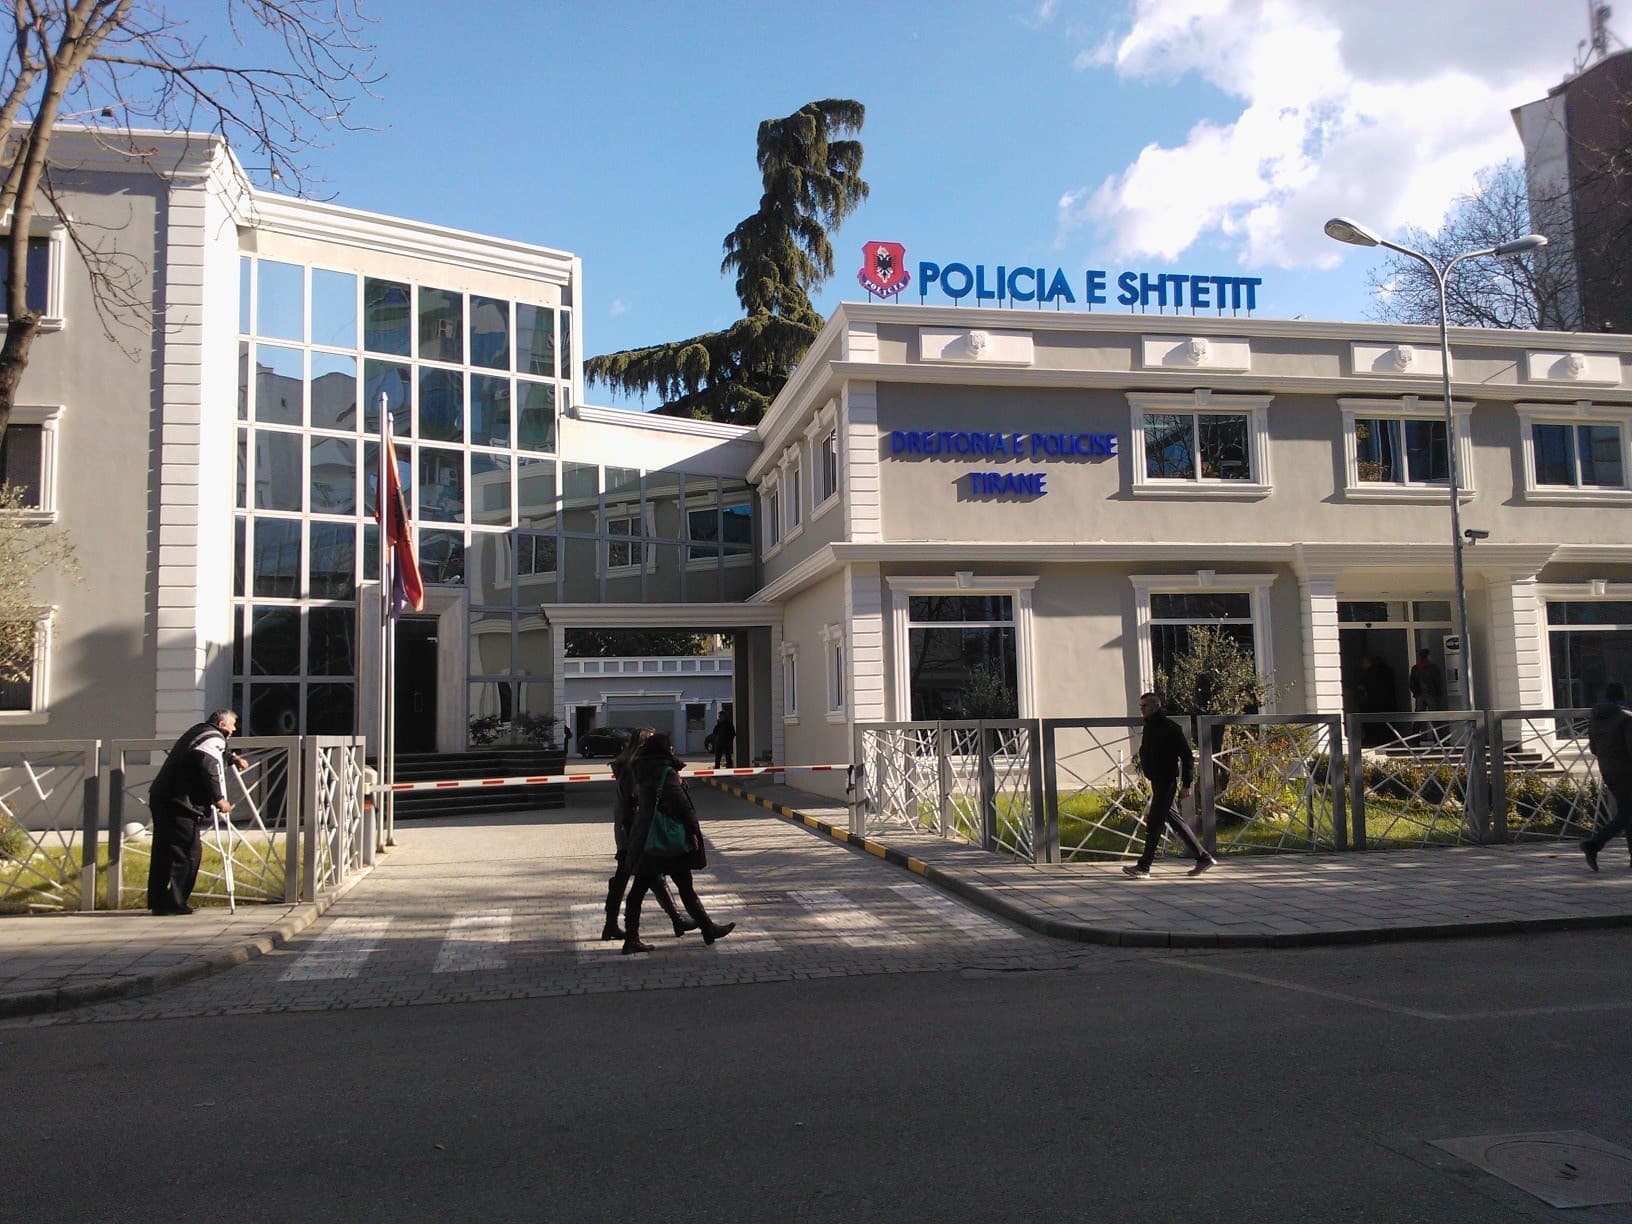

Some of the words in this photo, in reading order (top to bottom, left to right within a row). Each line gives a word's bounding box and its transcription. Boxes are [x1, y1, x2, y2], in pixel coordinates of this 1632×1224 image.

[864, 280, 905, 296] POLICIA
[919, 262, 1075, 303] POLICIA
[1086, 270, 1106, 304] E
[1117, 271, 1262, 310] SHTETIT
[892, 430, 1006, 456] DREJTORIA
[1013, 432, 1028, 456] E
[1030, 433, 1118, 457] POLICISE
[967, 472, 1048, 496] TIRANE
